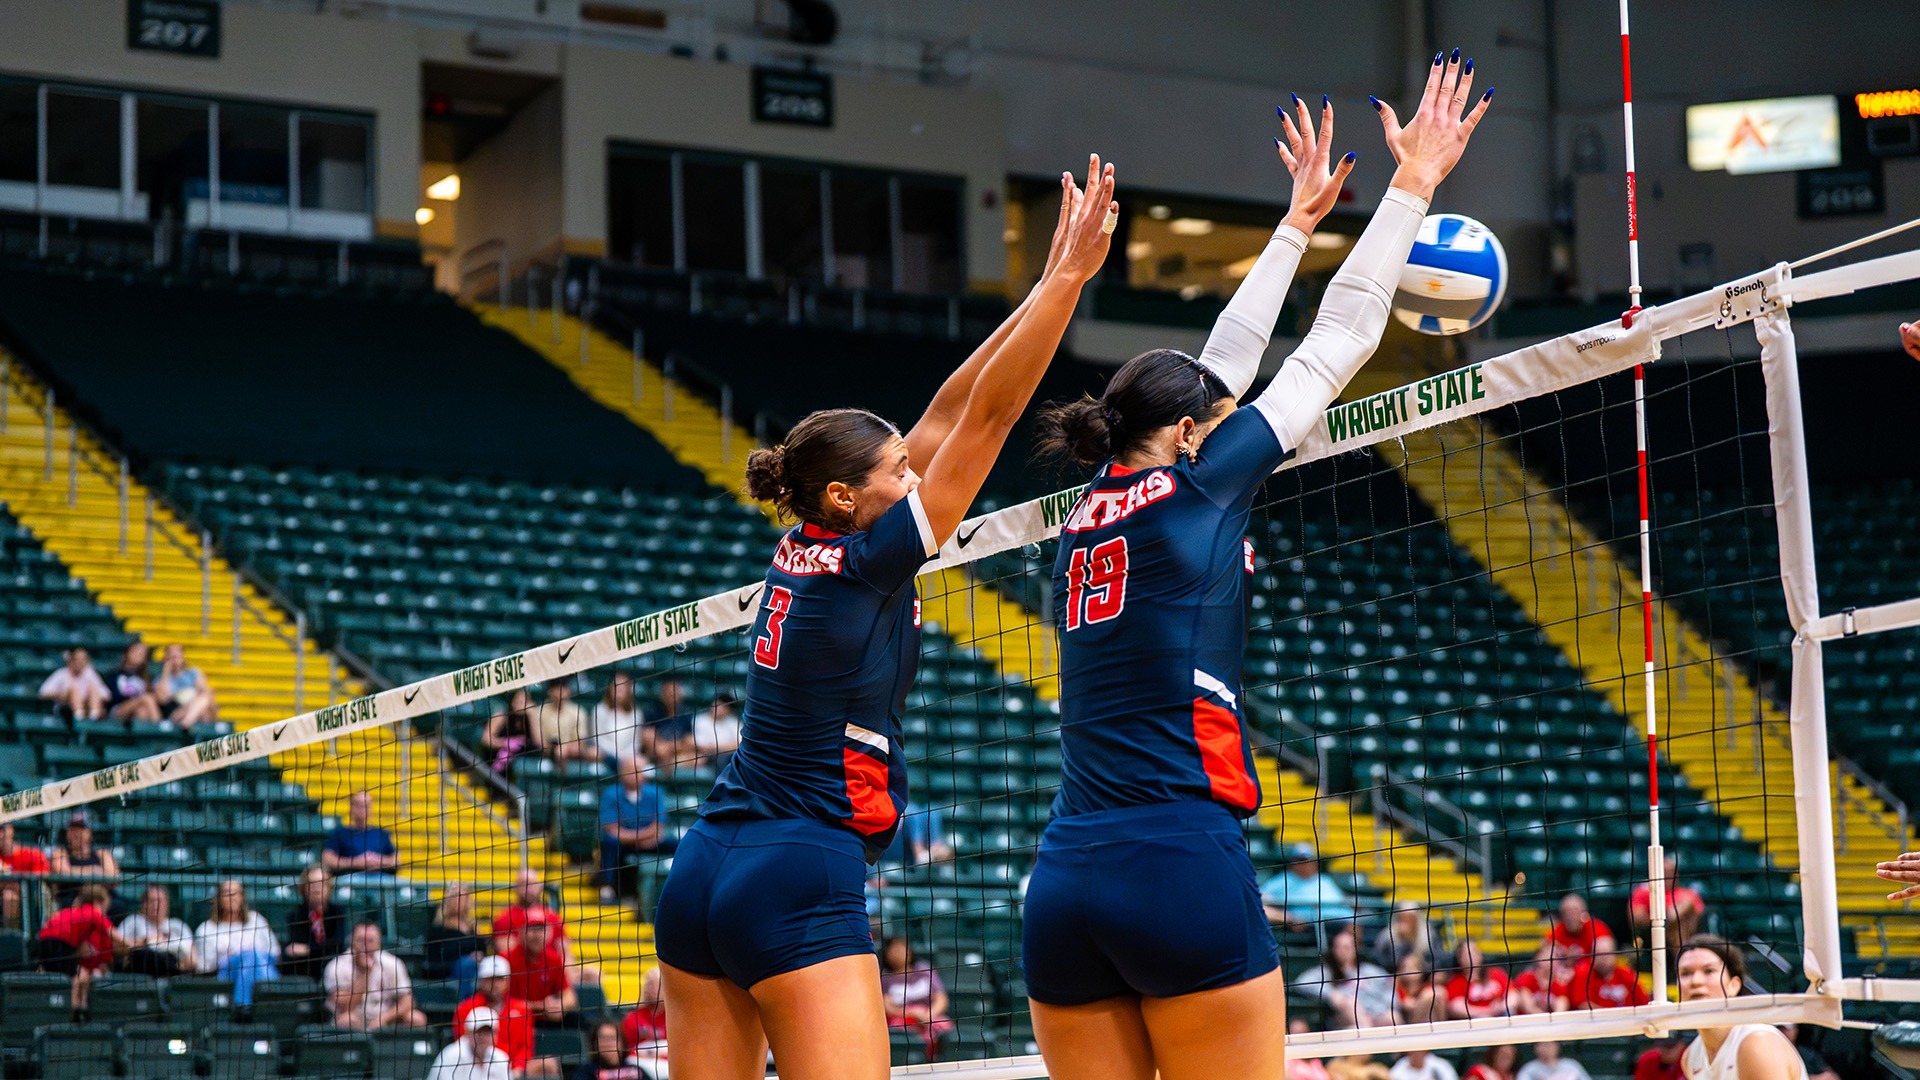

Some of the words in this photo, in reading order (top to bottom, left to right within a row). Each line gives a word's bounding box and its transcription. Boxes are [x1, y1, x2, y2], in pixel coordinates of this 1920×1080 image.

[141, 20, 208, 48] 207
[1734, 279, 1764, 297] Senoh
[1327, 386, 1410, 444] WRIGHT
[1417, 363, 1486, 417] STATE
[772, 532, 845, 576] LYERS
[1066, 536, 1129, 632] 19
[614, 613, 660, 651] WRIGHT
[664, 602, 699, 637] STATE
[754, 585, 793, 670] 3
[453, 663, 492, 696] WRIGHT
[495, 654, 525, 685] STATE
[315, 703, 348, 733] WRIGHT
[350, 694, 377, 723] STATE
